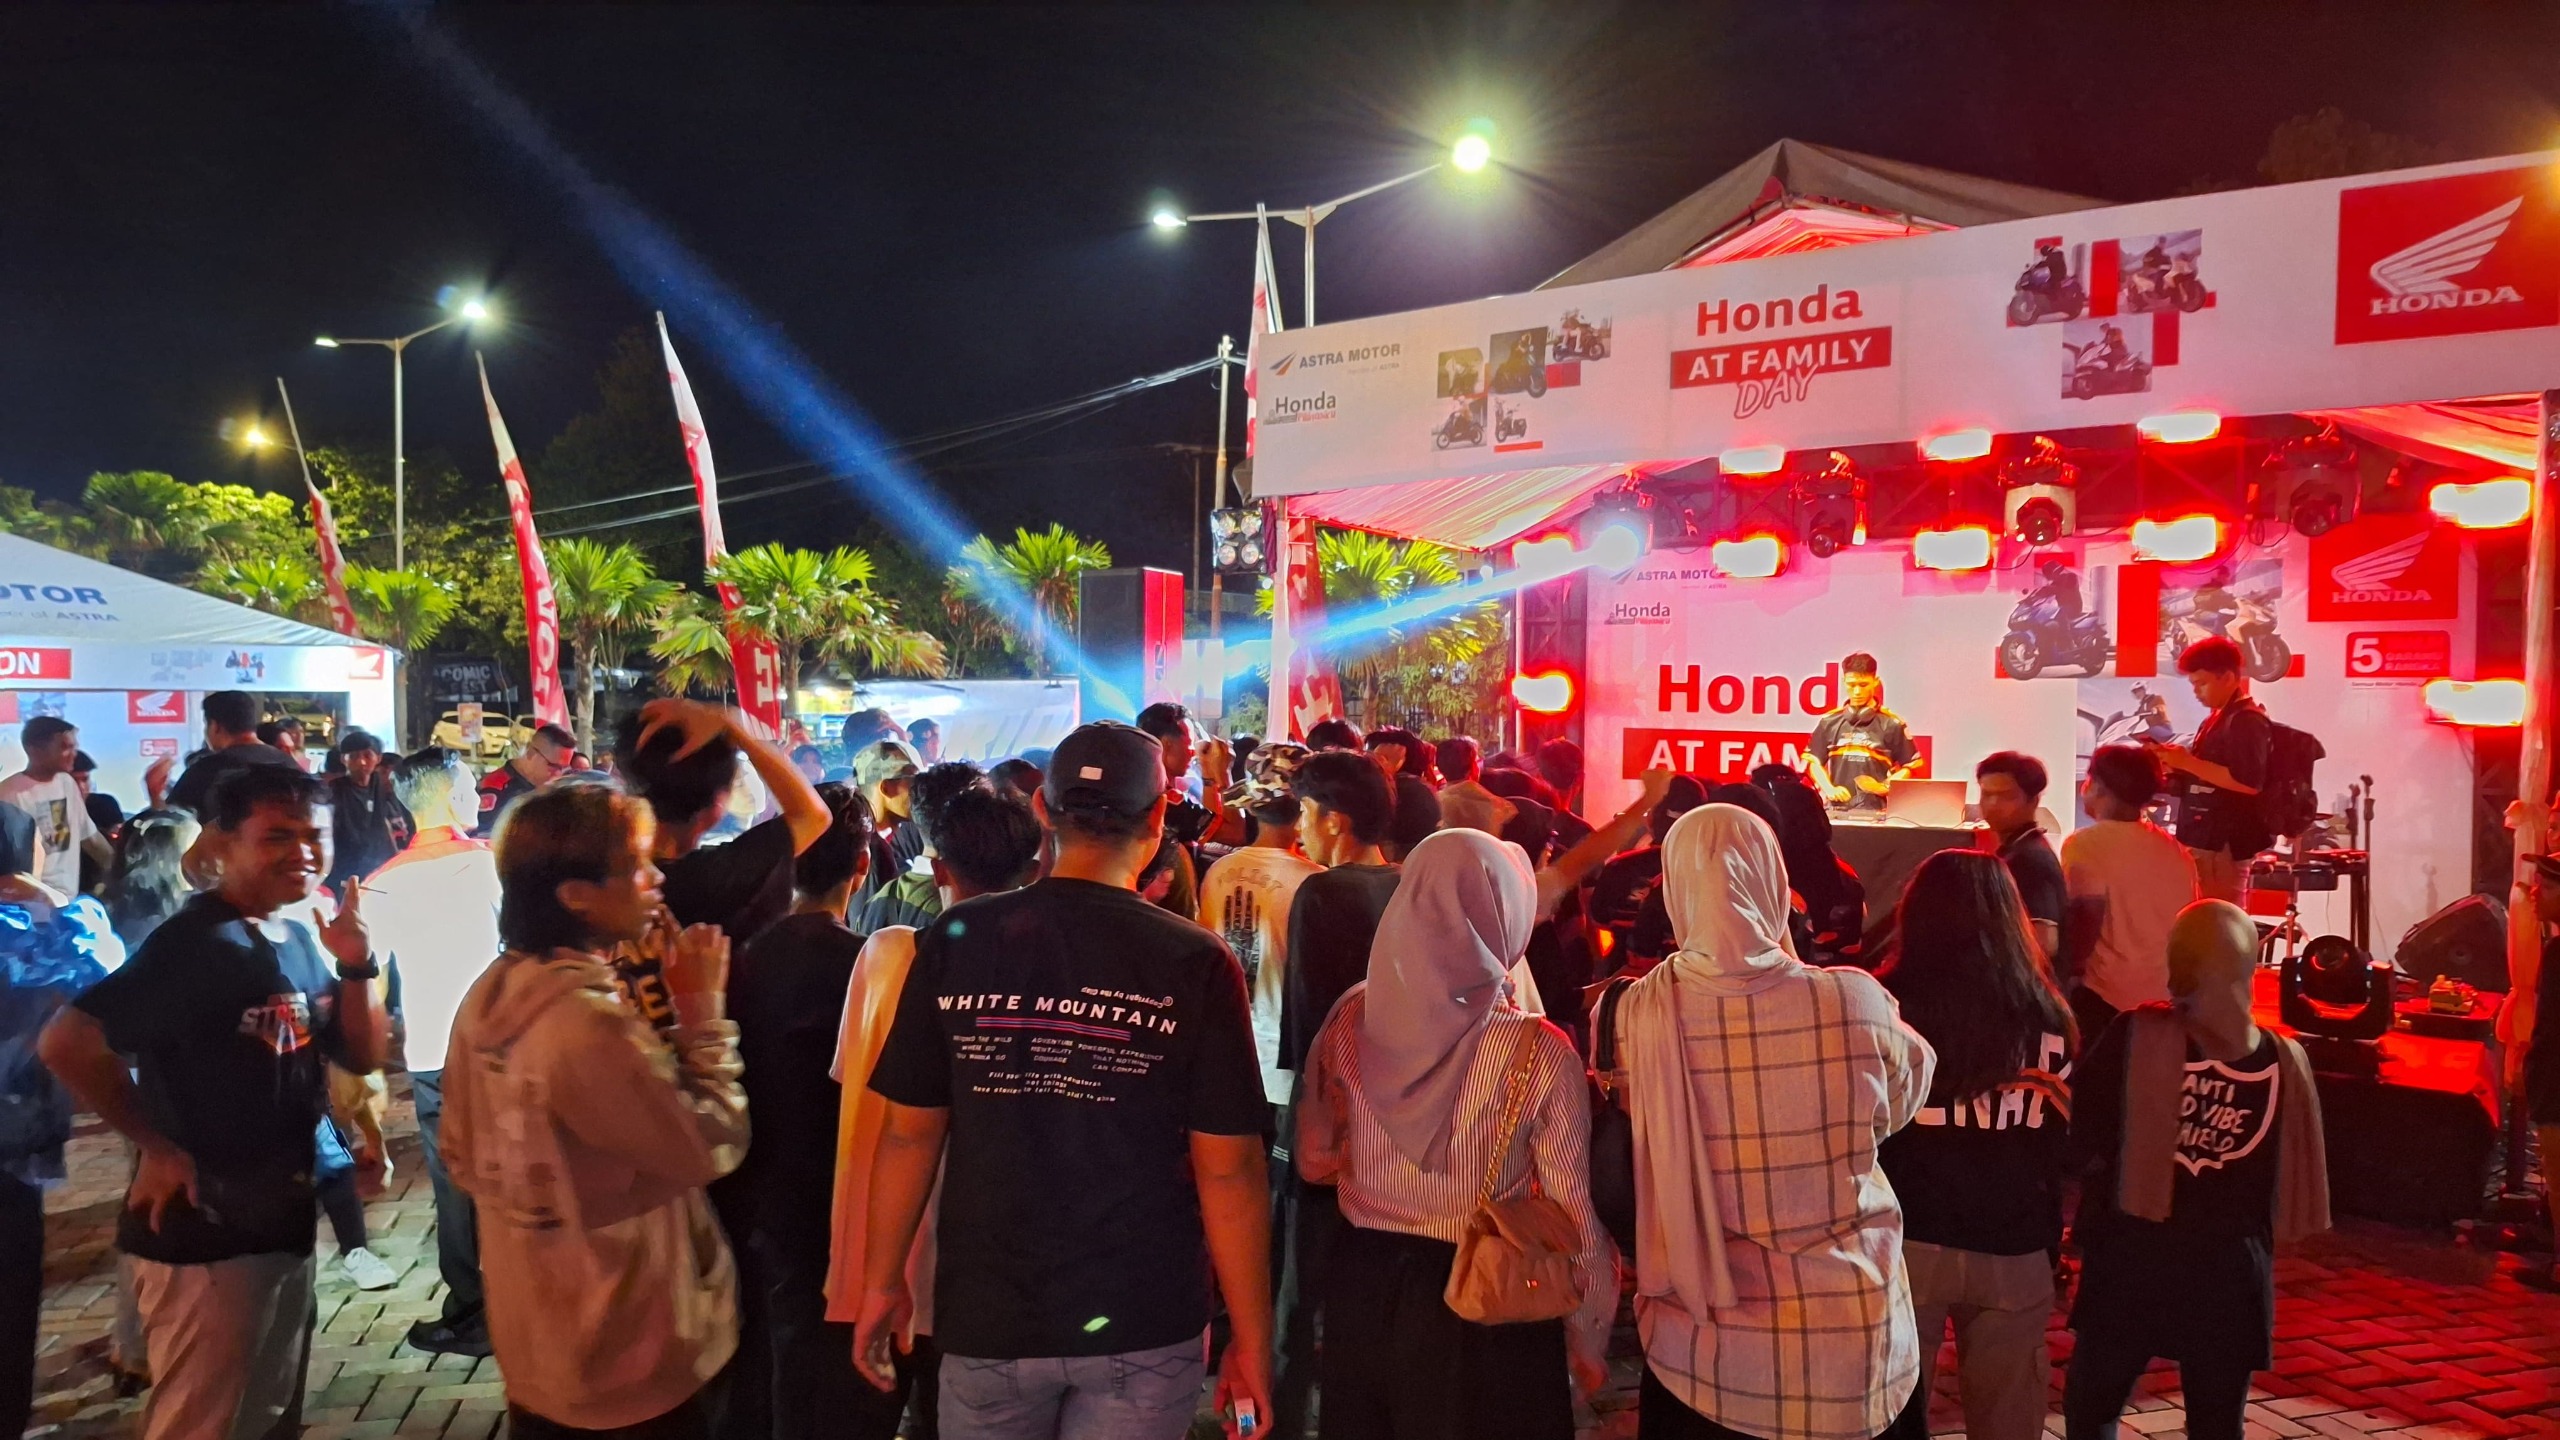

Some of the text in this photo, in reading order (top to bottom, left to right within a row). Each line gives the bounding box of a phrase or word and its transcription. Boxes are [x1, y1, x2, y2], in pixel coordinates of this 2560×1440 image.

[1697, 283, 1863, 337] Honda
[2369, 286, 2525, 316] HONDA
[1299, 343, 1401, 369] ASTRA MOTOR
[1688, 336, 1872, 381] AT FAMILY
[1275, 390, 1336, 414] Honda
[1734, 362, 1819, 419] DAY
[1637, 569, 1722, 581] ASTRA MOTO
[1615, 602, 1671, 618] Honda
[2331, 590, 2433, 603] HONDA
[2351, 637, 2383, 674] 5
[1658, 662, 1883, 716] Hond
[142, 741, 154, 757] 5
[1648, 739, 1809, 775] AT FAM
[937, 994, 1177, 1035] WHITE MOUNTAIN
[2181, 1074, 2235, 1103] ANTI
[2201, 1100, 2253, 1134] VIBE
